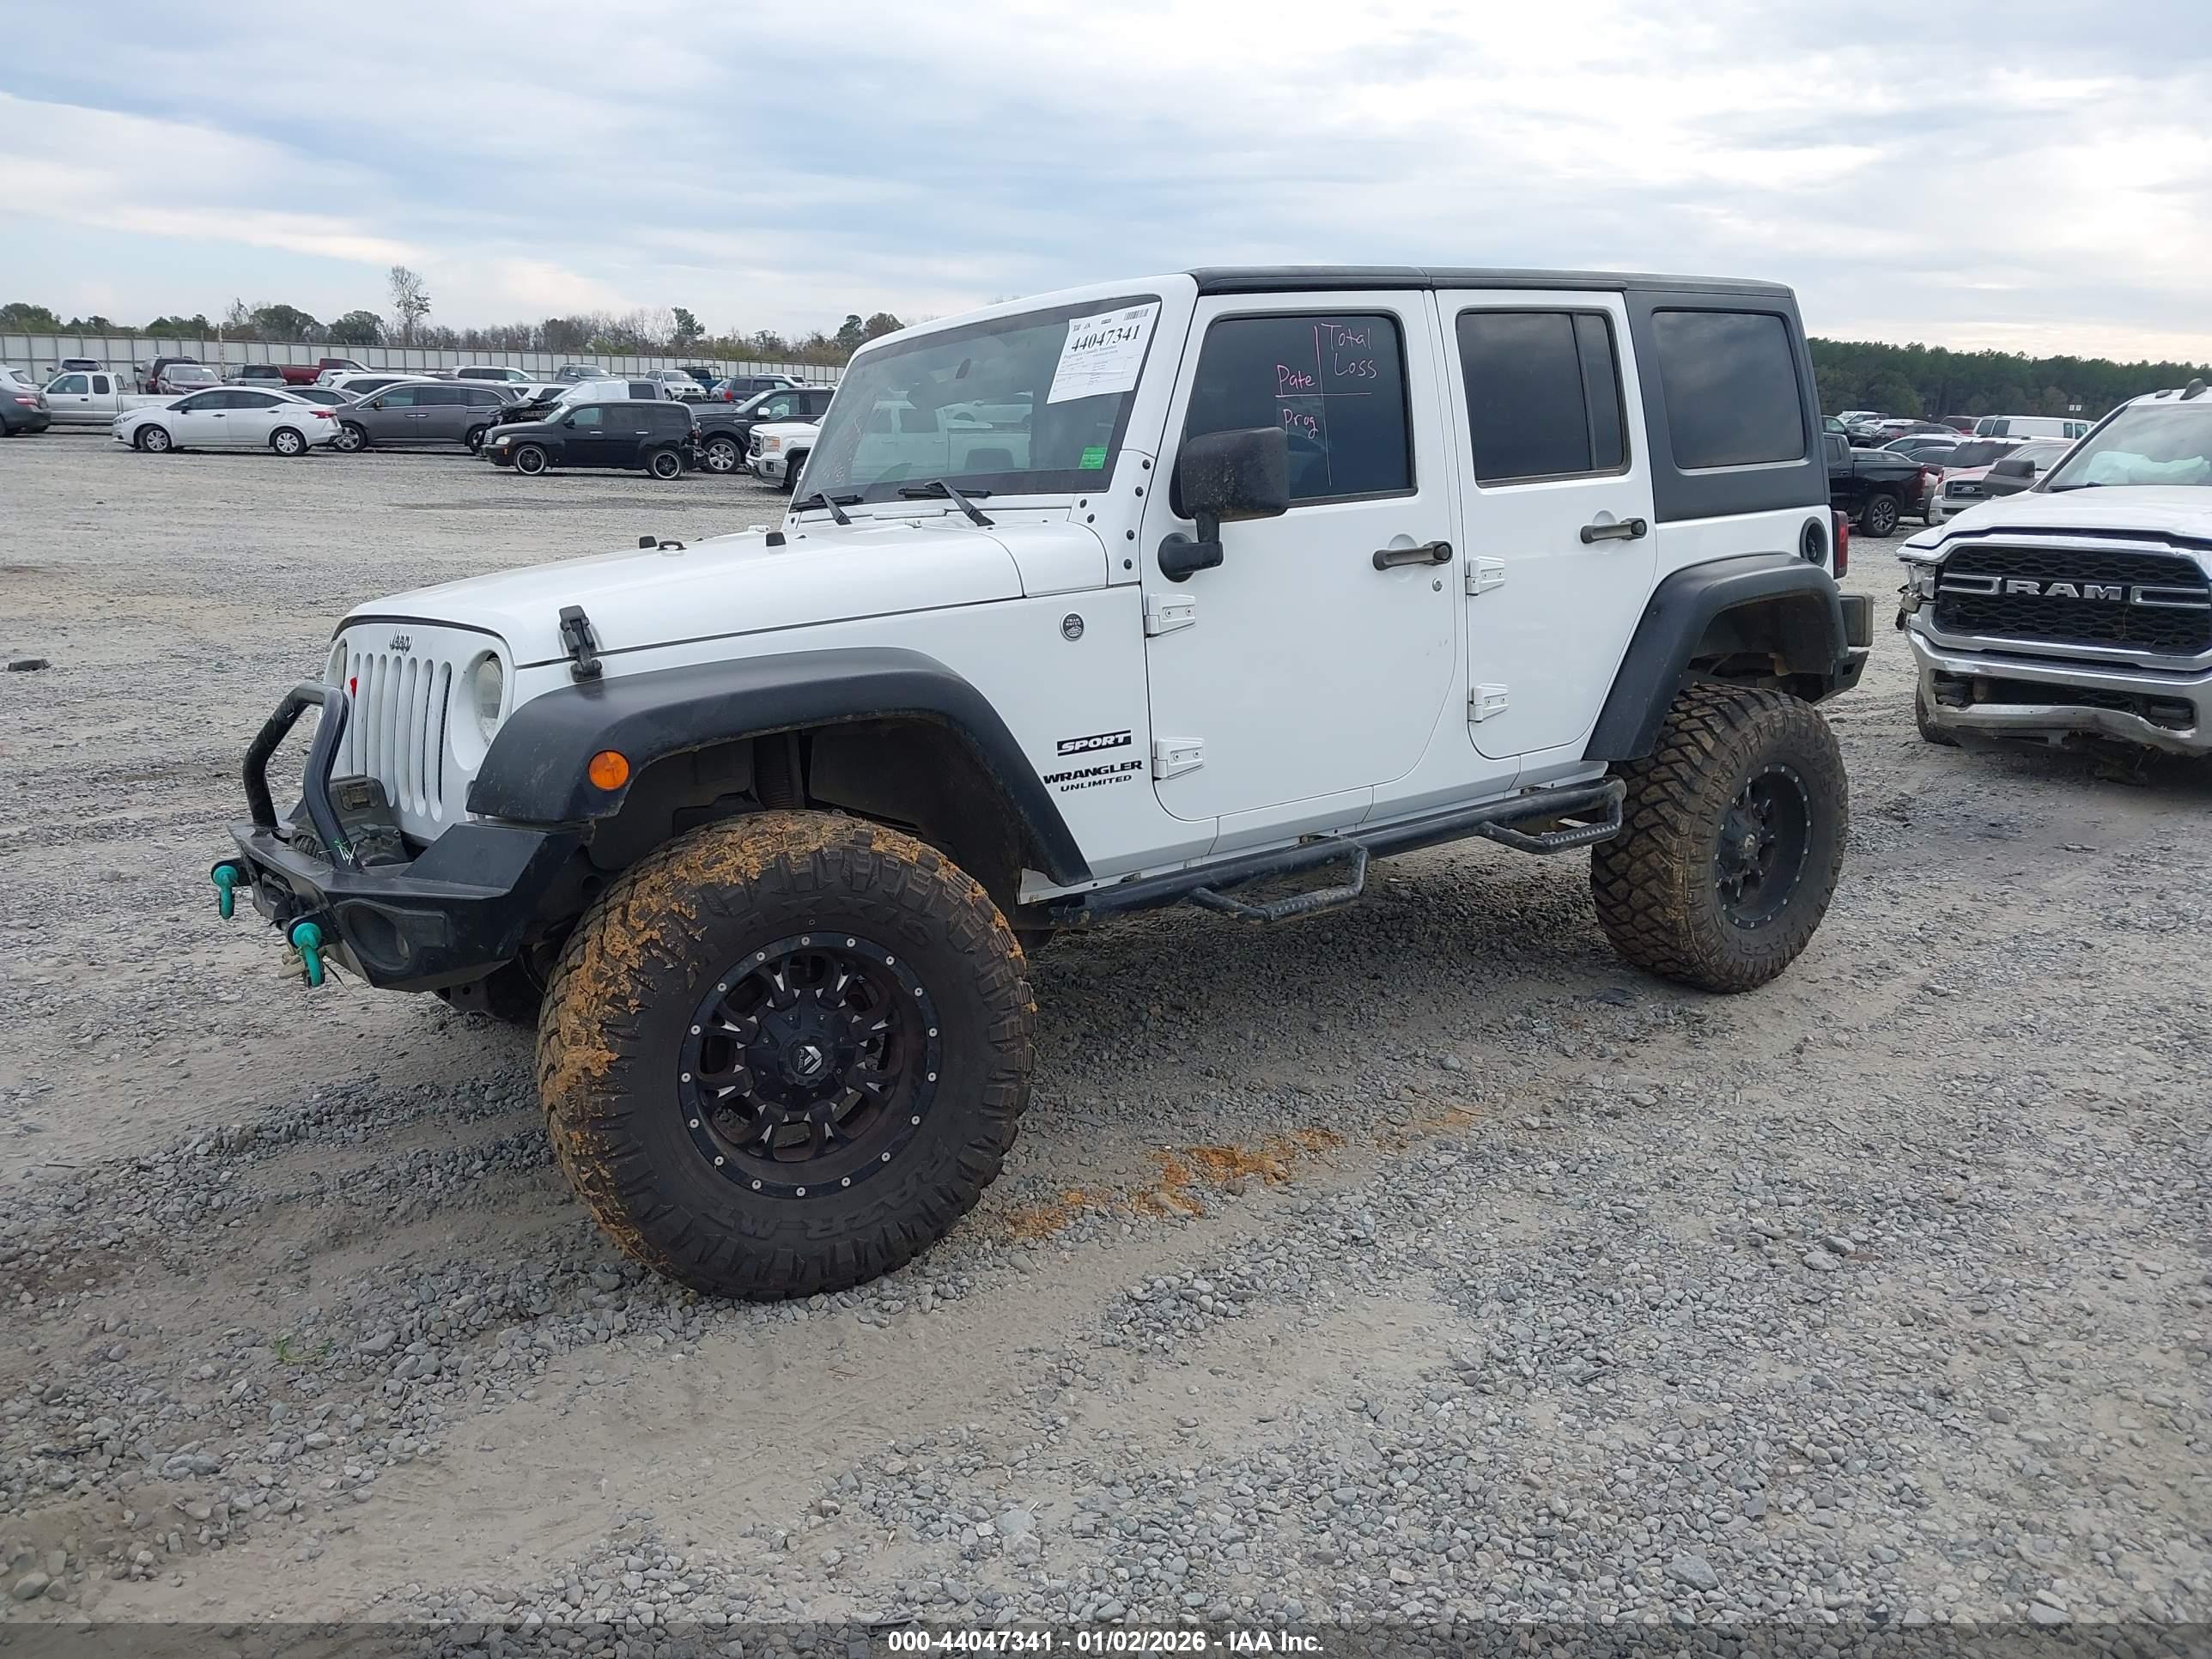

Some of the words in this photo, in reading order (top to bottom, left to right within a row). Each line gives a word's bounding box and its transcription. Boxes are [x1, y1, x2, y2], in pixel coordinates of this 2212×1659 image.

[1072, 324, 1140, 352] 44047341
[1321, 323, 1372, 350] Total
[1334, 352, 1378, 380] Loss
[1283, 409, 1319, 440] Prog
[2005, 580, 2123, 601] RAM
[1059, 732, 1131, 753] SPORT
[1043, 760, 1144, 785] WRANGLER
[1060, 775, 1133, 792] UNLIMITED
